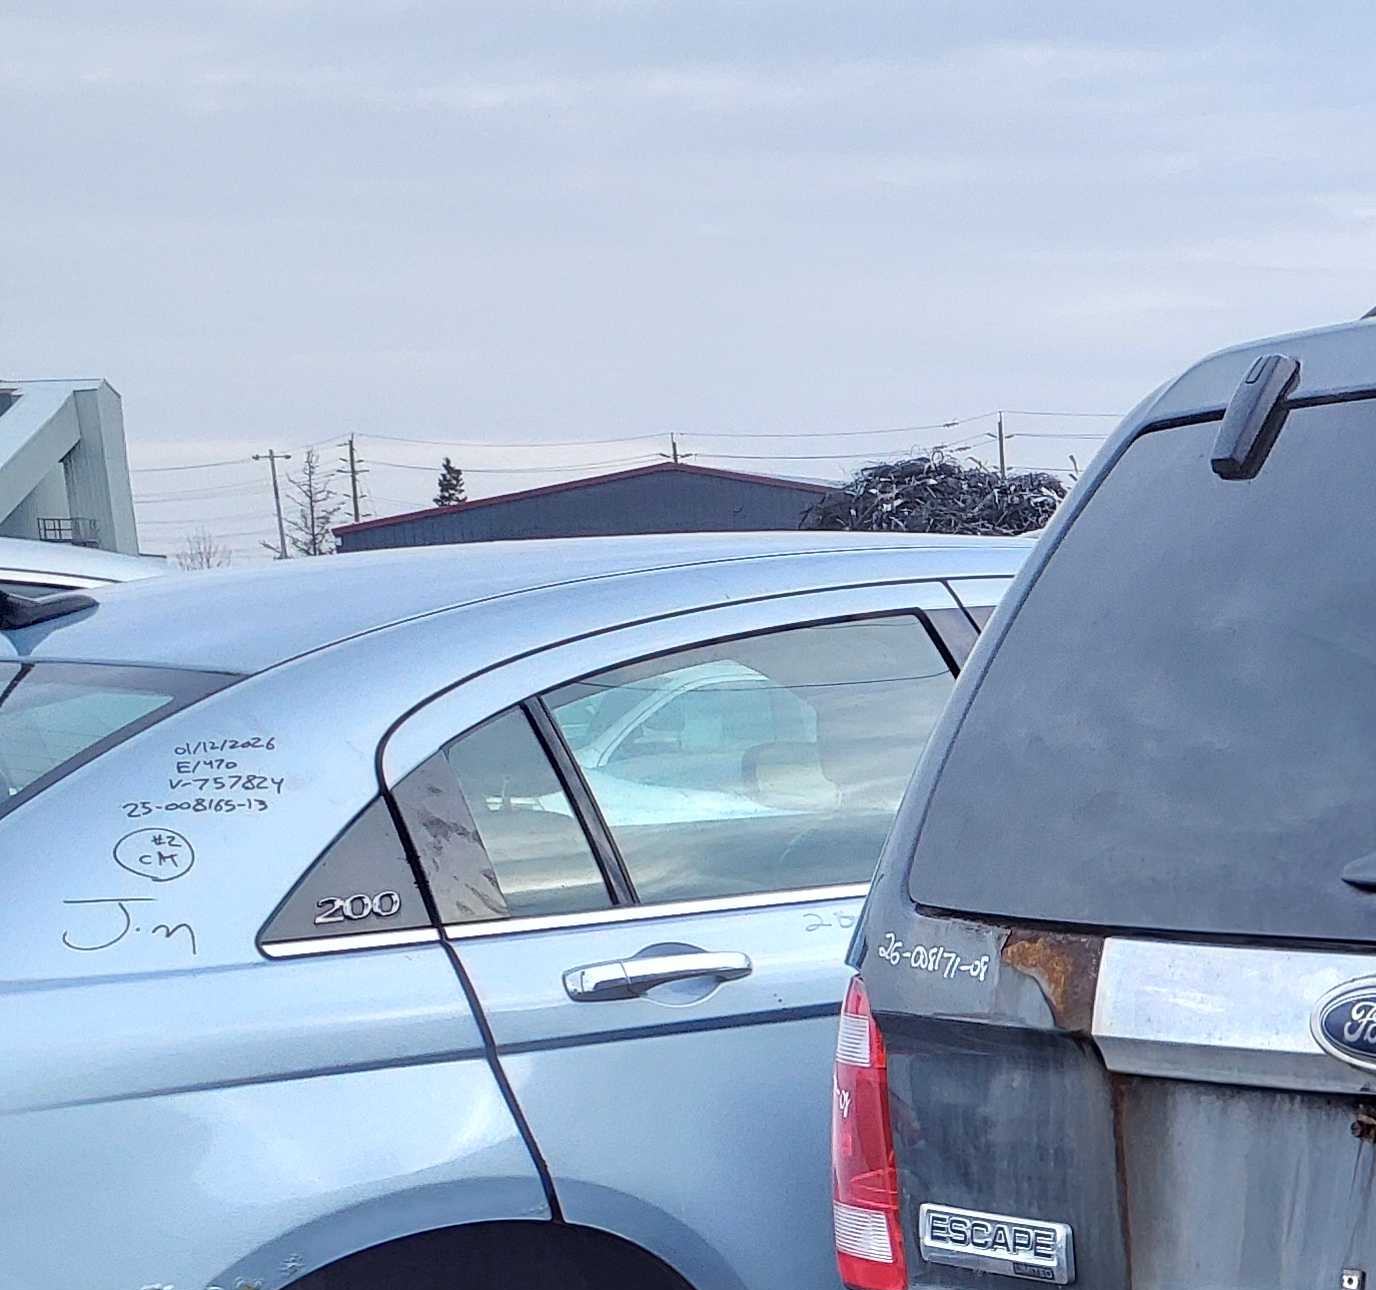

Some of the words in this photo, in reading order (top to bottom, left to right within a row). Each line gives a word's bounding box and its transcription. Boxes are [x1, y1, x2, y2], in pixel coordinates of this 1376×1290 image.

[174, 736, 276, 755] 01/12/2026
[176, 758, 238, 774] E/470
[122, 798, 269, 818] 25-008165-13
[314, 890, 401, 924] 200
[929, 1212, 1056, 1261] ESCAPE
